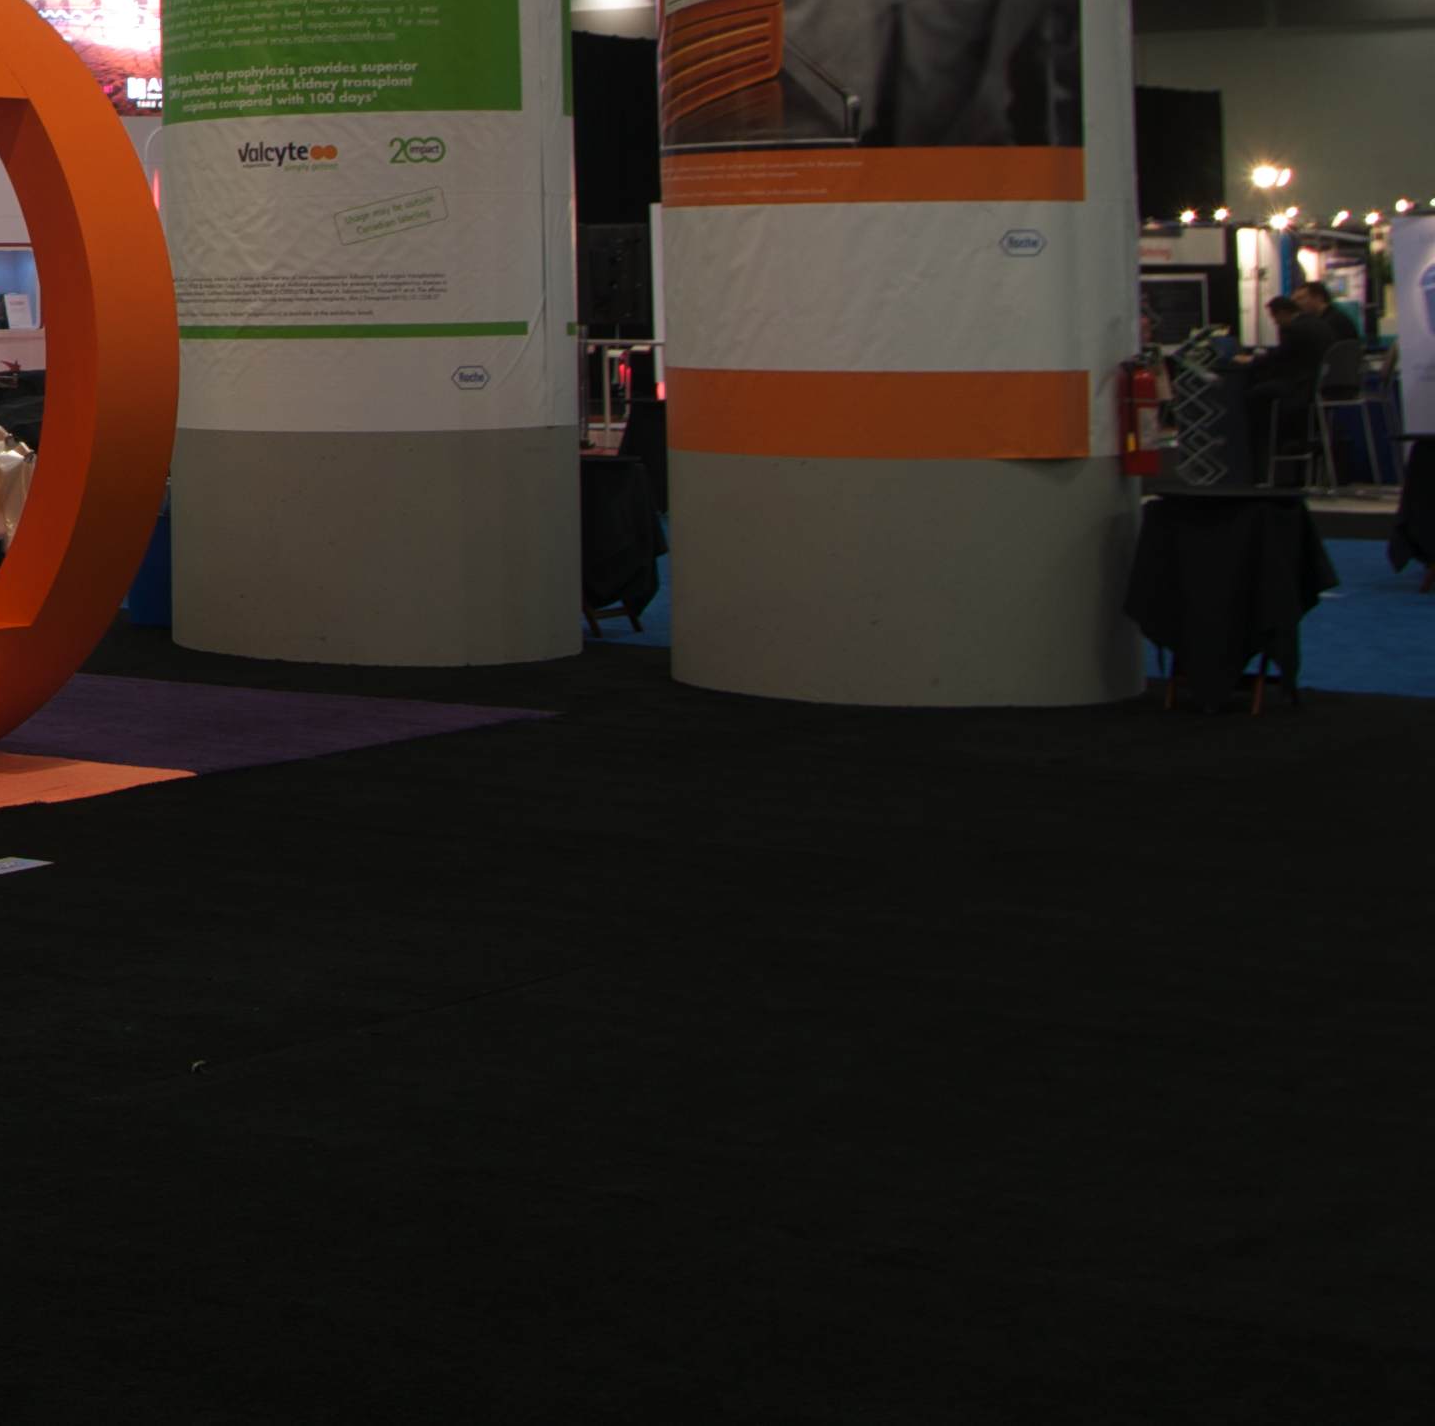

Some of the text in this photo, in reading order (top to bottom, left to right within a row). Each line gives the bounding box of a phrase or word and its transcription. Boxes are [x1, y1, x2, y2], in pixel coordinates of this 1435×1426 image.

[226, 64, 295, 82] prophylaxis
[299, 61, 357, 77] provides
[361, 60, 418, 75] superior
[238, 78, 290, 95] high-risk
[292, 77, 339, 92] kidney
[342, 75, 414, 90] transplant
[219, 94, 273, 111] compared
[276, 92, 305, 106] with
[309, 92, 335, 105] 100
[238, 142, 308, 166] Valcyte
